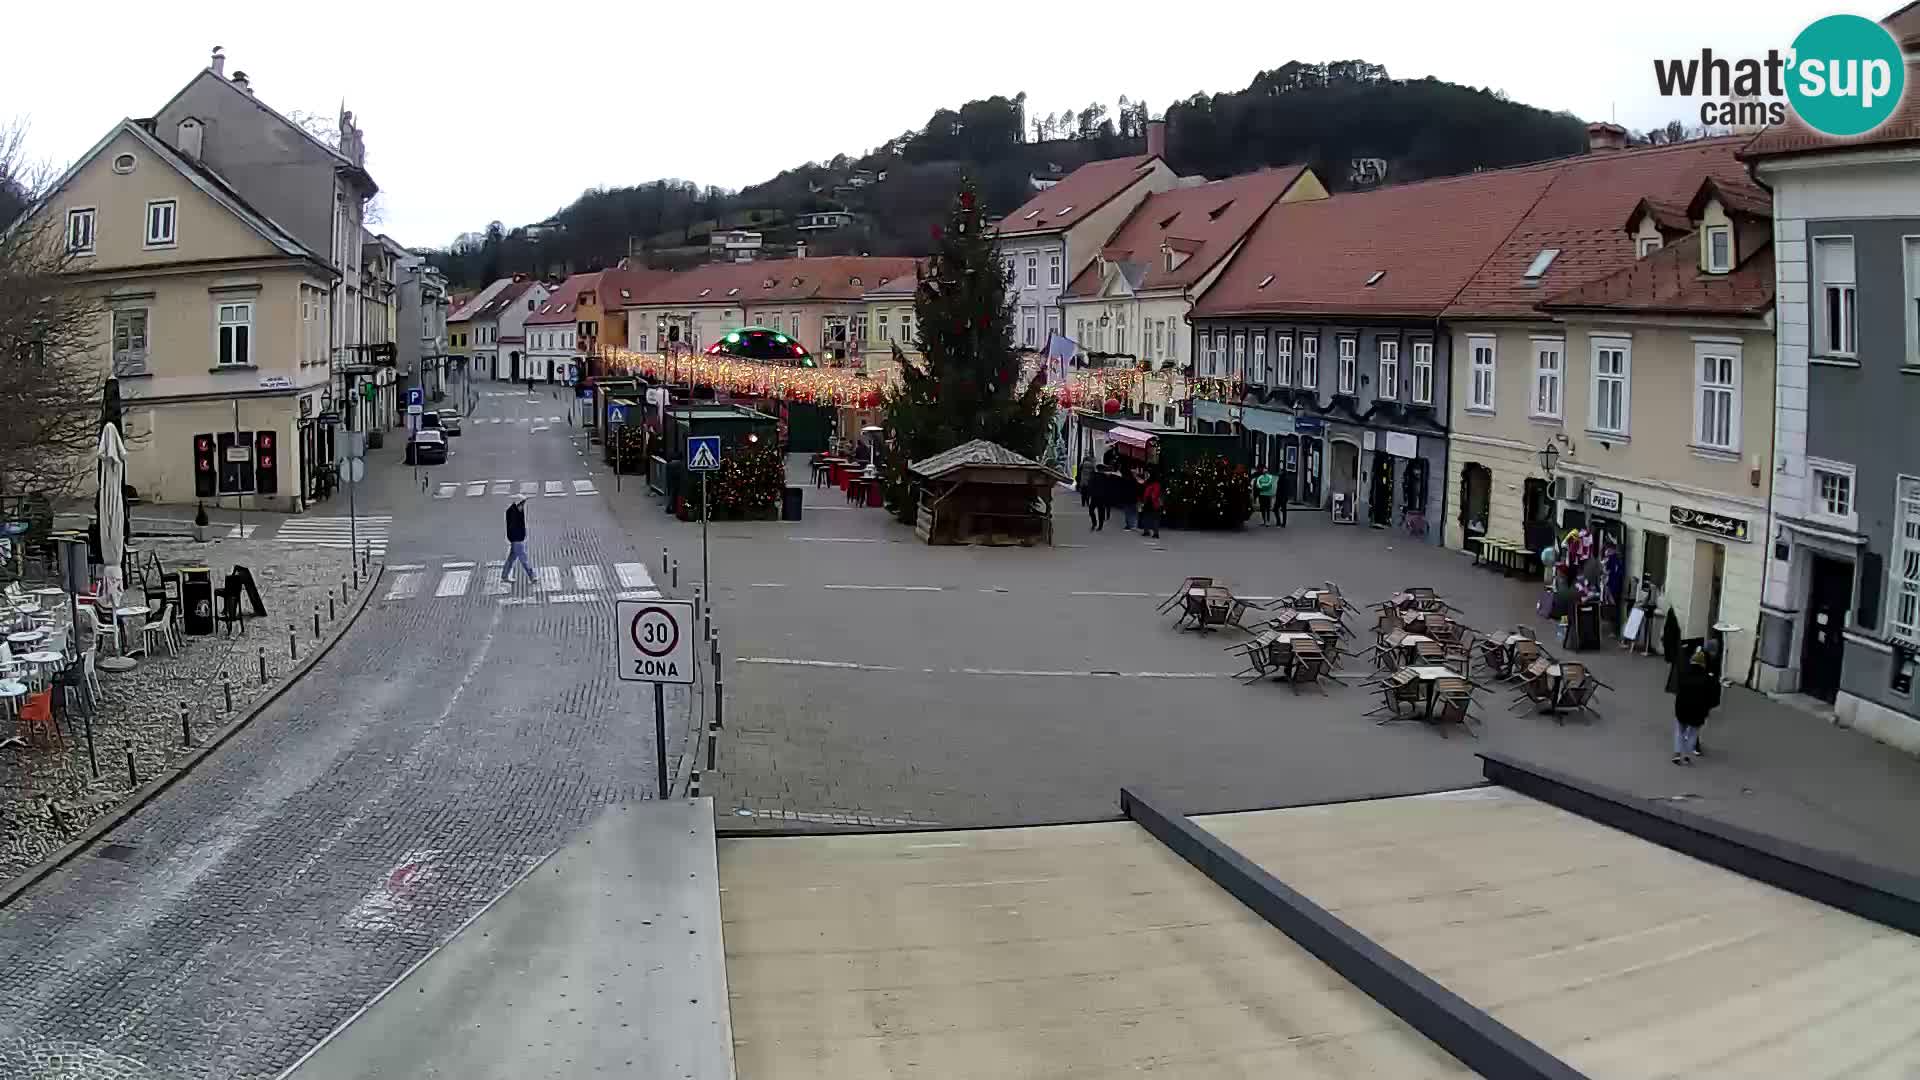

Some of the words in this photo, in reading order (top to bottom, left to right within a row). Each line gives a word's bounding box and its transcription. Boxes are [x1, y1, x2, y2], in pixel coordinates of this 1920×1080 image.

[411, 391, 419, 404] P
[644, 623, 668, 644] 30
[634, 660, 679, 677] ZONA
